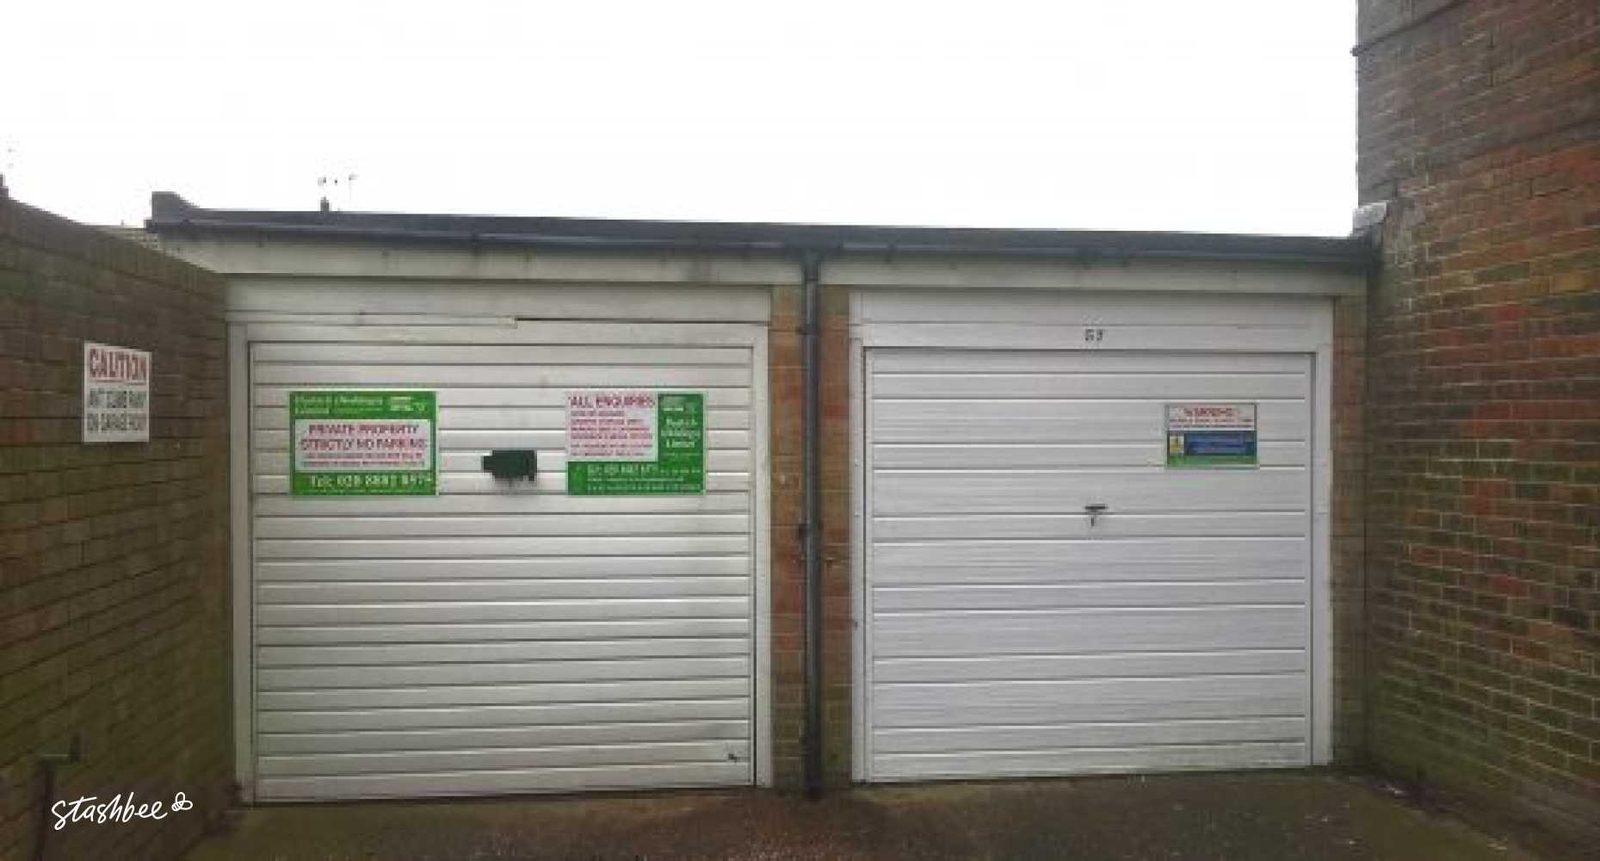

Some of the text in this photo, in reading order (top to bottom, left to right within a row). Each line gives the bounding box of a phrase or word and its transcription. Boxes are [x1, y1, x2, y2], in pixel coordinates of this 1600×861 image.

[89, 347, 147, 381] CAUTION
[595, 394, 655, 407] ENQUIRIES
[308, 423, 420, 434] PRIVATE PROPERTY
[300, 438, 427, 451] STRICTLY NO PARKING
